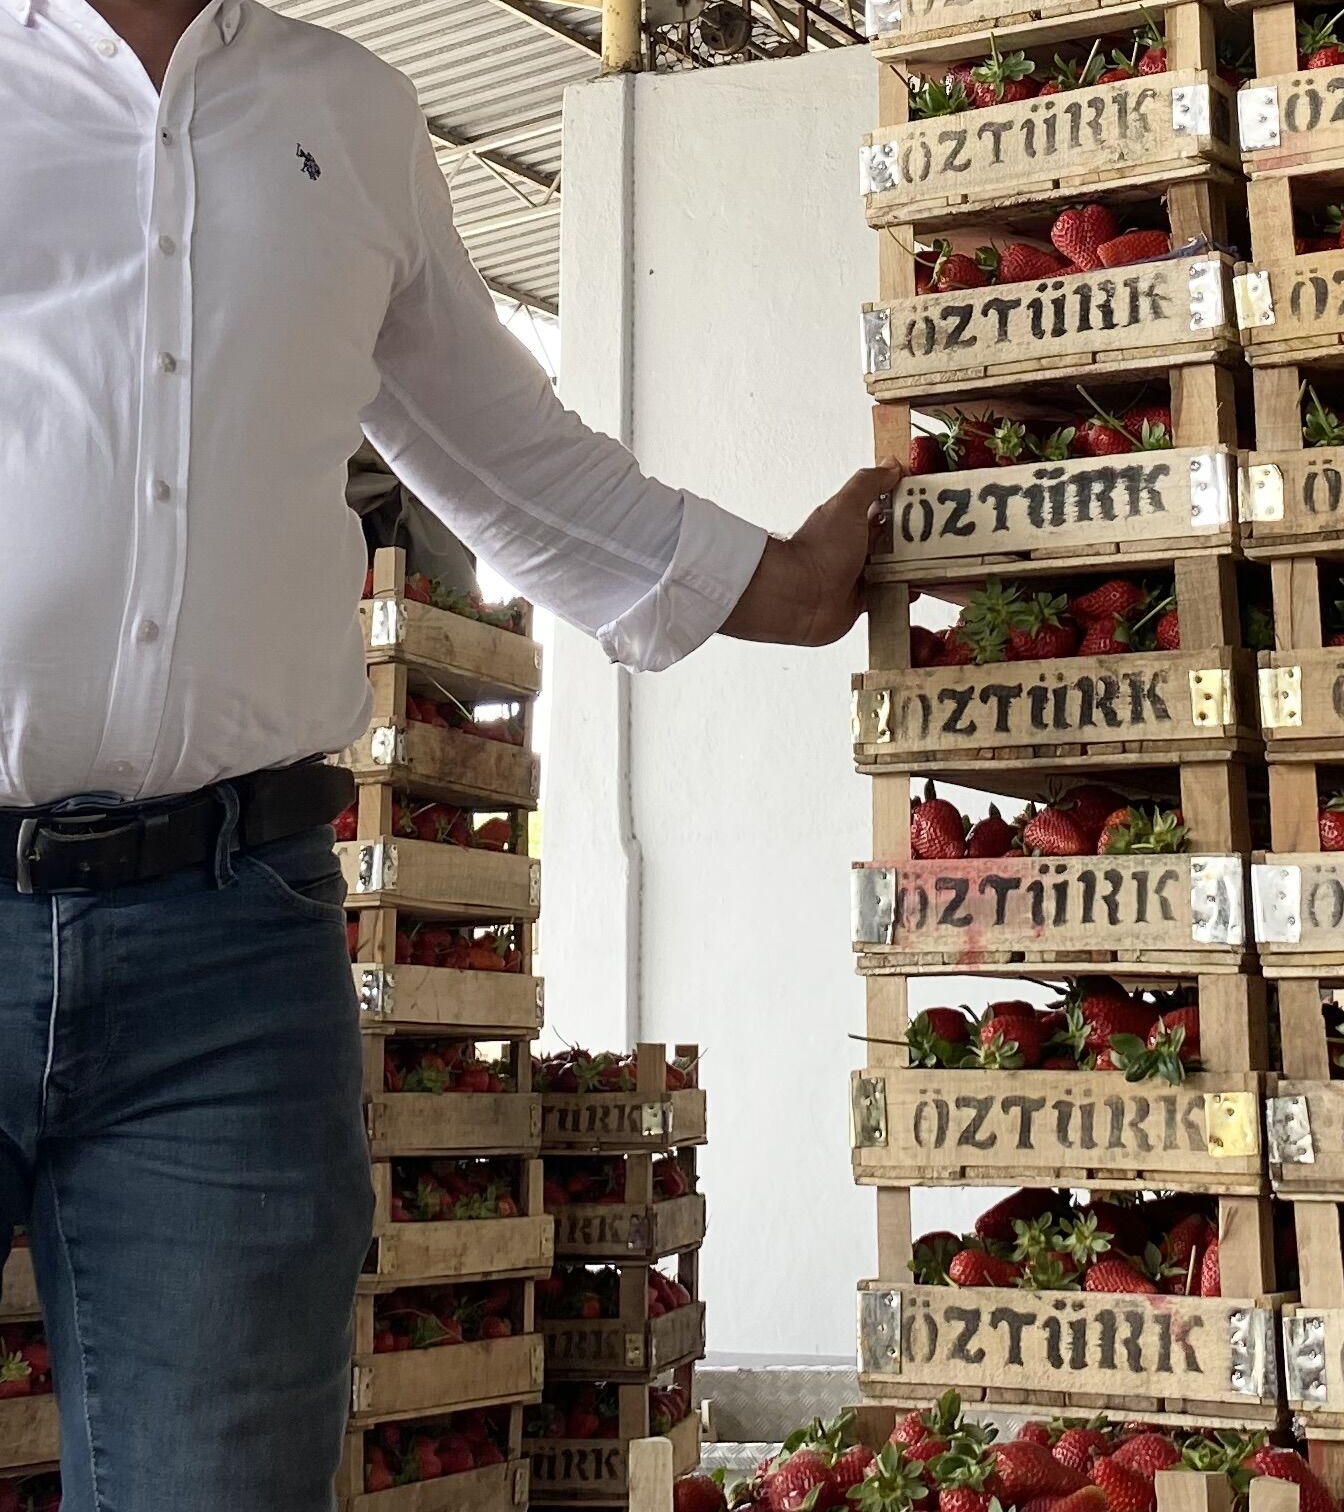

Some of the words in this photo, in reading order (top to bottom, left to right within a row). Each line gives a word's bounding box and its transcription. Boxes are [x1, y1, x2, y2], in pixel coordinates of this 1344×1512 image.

[901, 88, 1158, 184] ÖZTÜRK
[904, 274, 1173, 358] ÖZTÜRK
[901, 463, 1171, 543] ÖZTÜRK
[896, 864, 1179, 930] ÖZTÜRK
[912, 1088, 1207, 1152] ÖZTÜRK
[902, 1298, 1205, 1375] ÖZTÜRK
